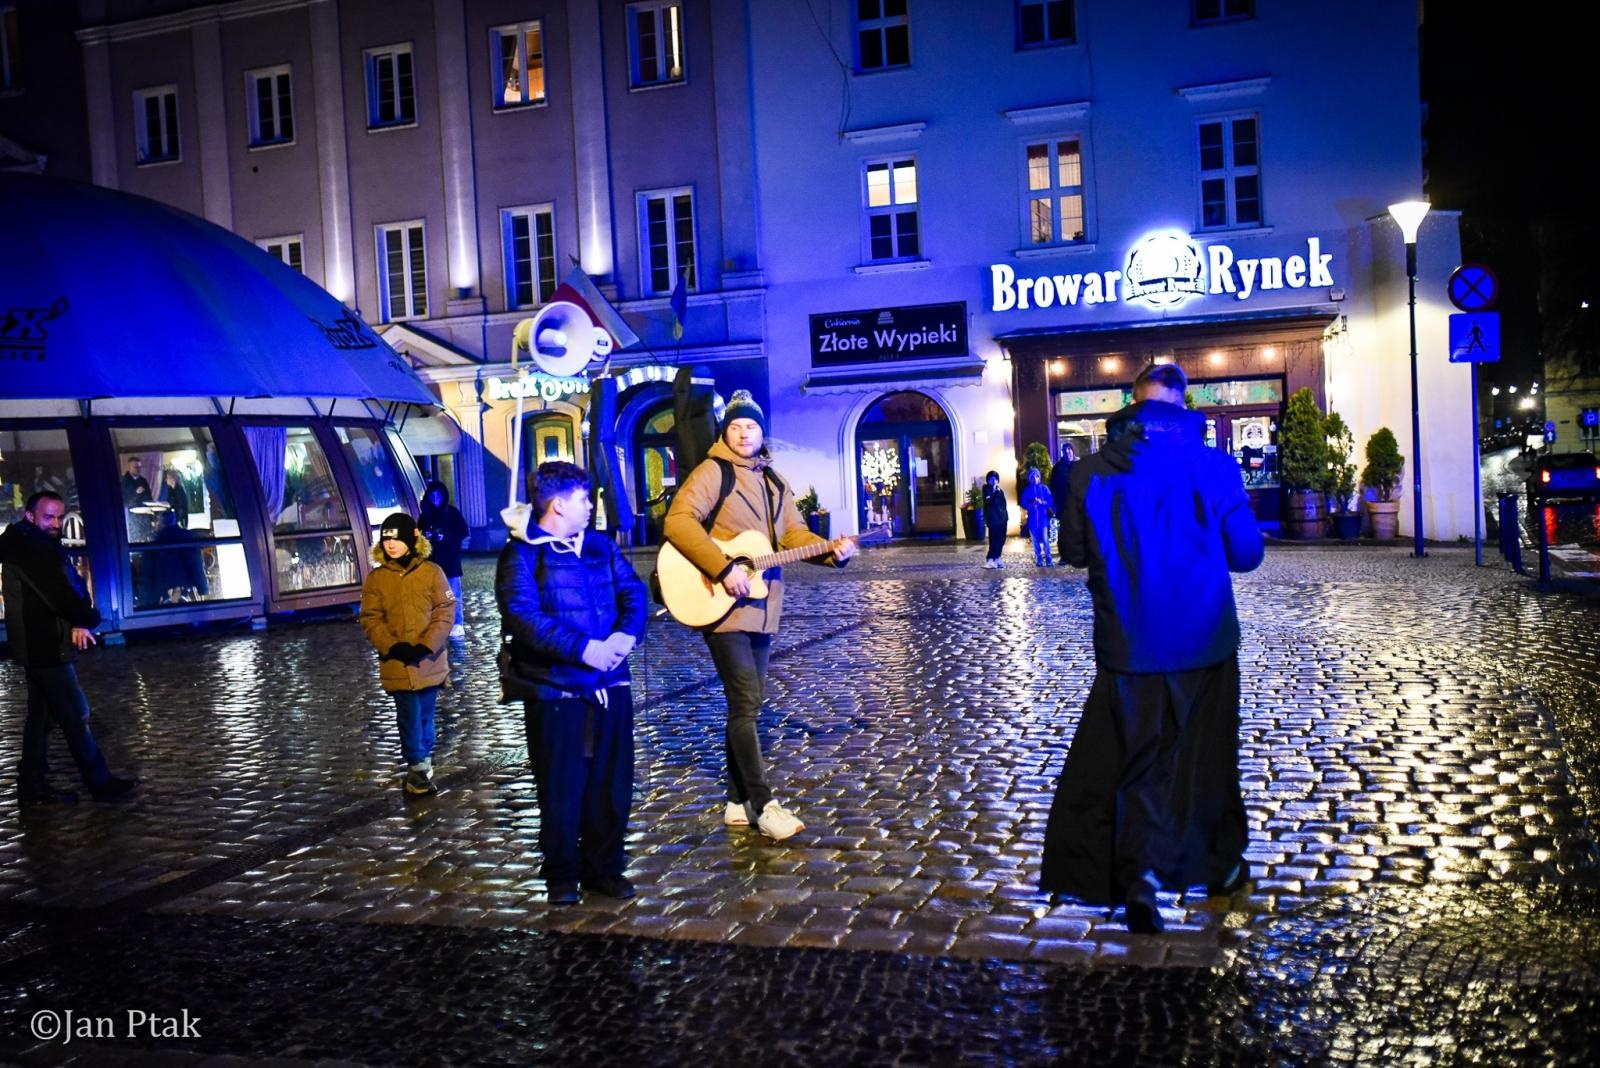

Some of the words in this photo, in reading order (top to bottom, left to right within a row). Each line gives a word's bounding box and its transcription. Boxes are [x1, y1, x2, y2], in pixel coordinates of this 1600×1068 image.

[991, 264, 1122, 311] Browar
[1207, 237, 1334, 299] Rynek
[819, 332, 869, 352] Złote
[874, 324, 957, 352] Wypieki
